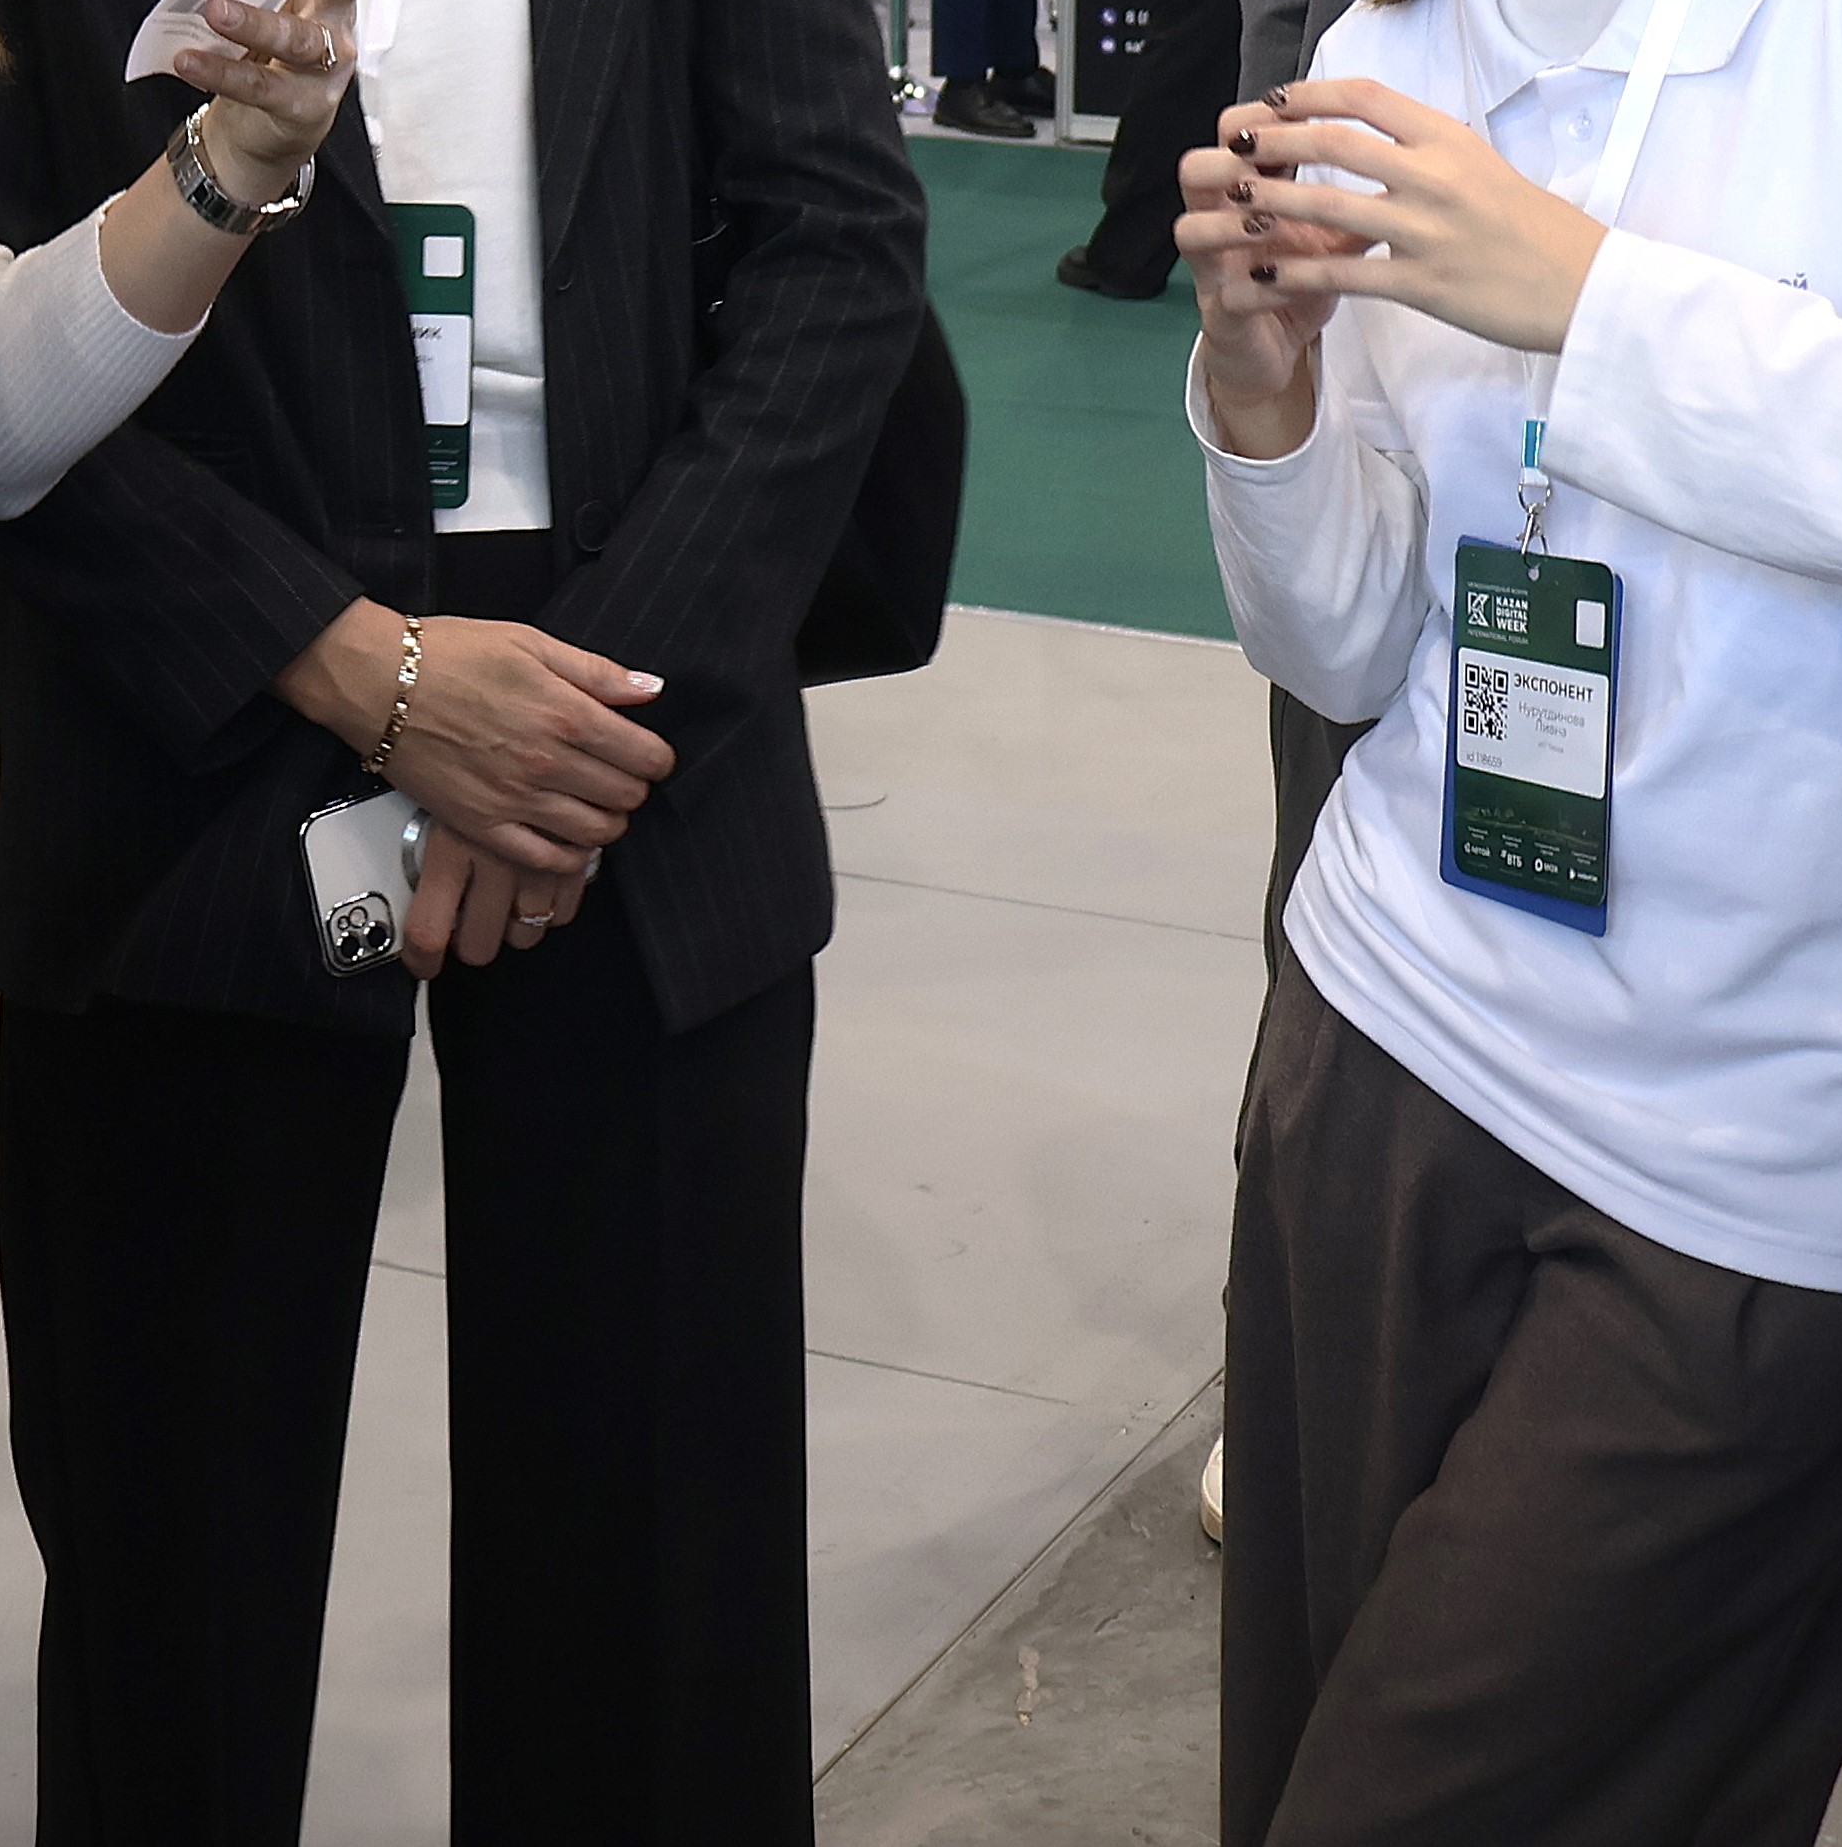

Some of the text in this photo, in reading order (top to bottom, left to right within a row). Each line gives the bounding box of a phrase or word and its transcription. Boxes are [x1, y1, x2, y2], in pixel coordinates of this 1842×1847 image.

[1496, 595, 1529, 611] KAZAN
[1496, 606, 1529, 622] DIGITAL
[1496, 617, 1529, 635] WEEK
[1513, 672, 1595, 703] ЭКСПОНЕНТ
[1506, 852, 1523, 869] ВТБ
